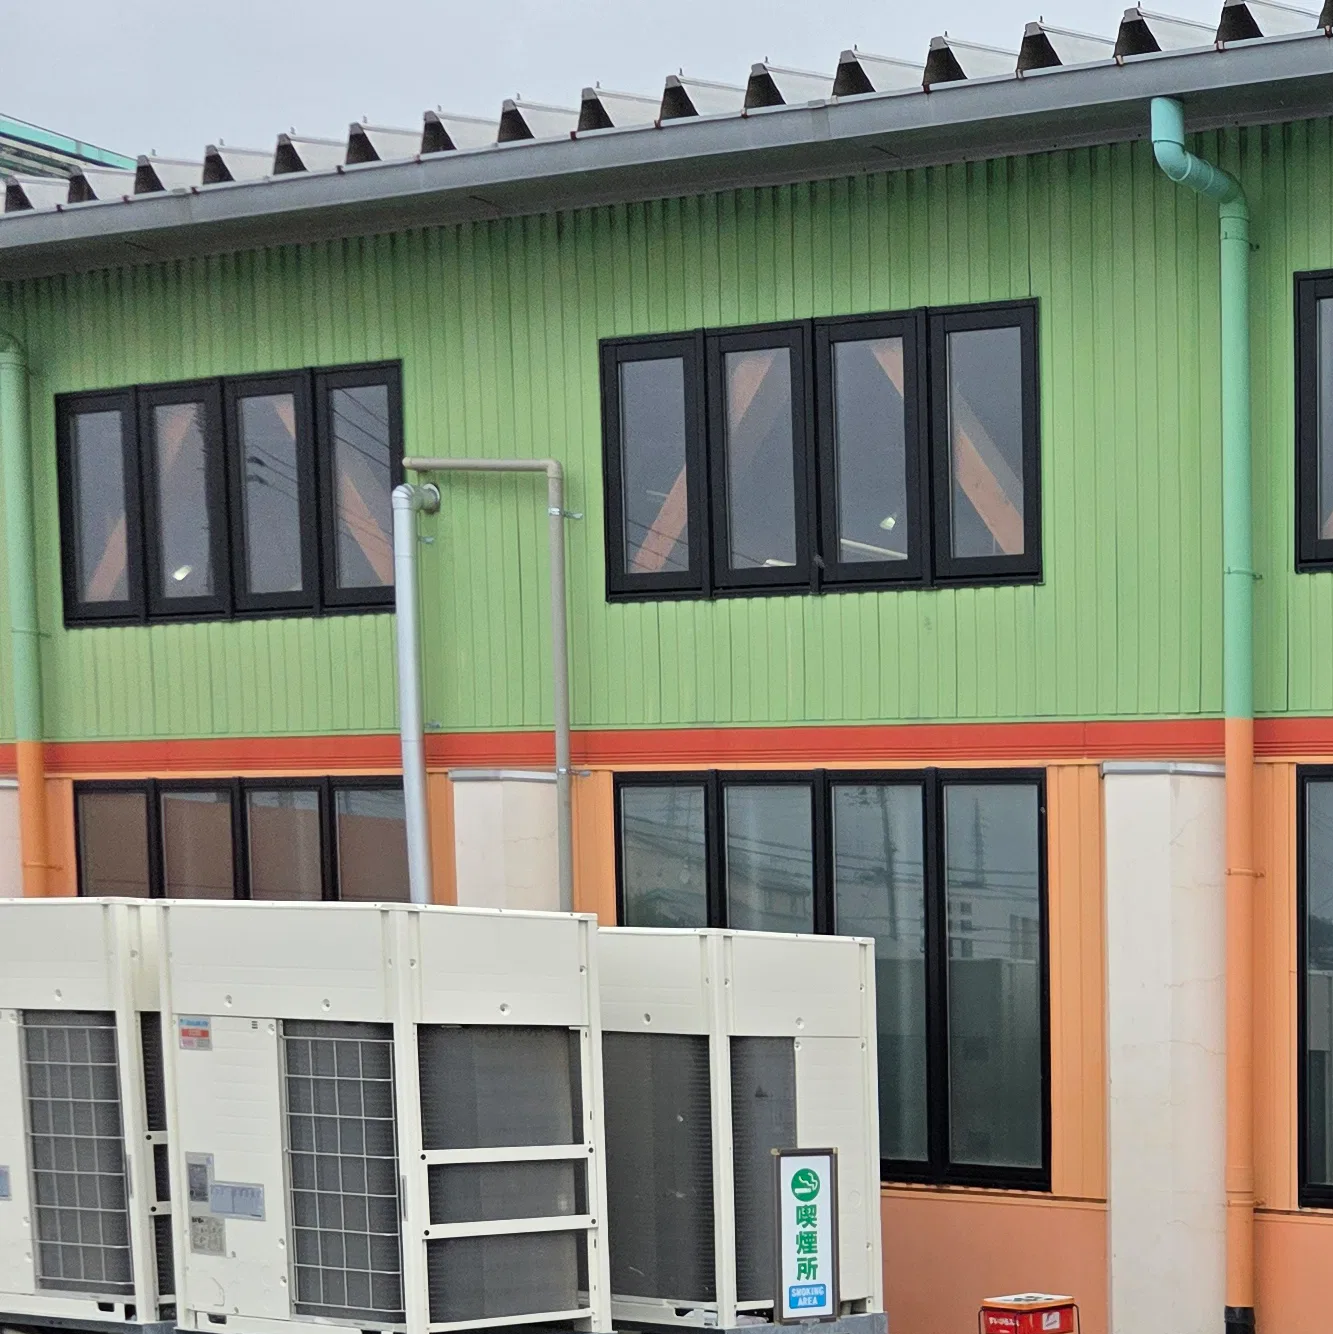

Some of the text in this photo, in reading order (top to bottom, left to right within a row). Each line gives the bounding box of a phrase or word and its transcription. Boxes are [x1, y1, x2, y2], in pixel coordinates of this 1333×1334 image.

[795, 1203, 819, 1281] 喫煙所
[791, 1285, 825, 1297] SMOKING
[797, 1296, 819, 1307] AREA
